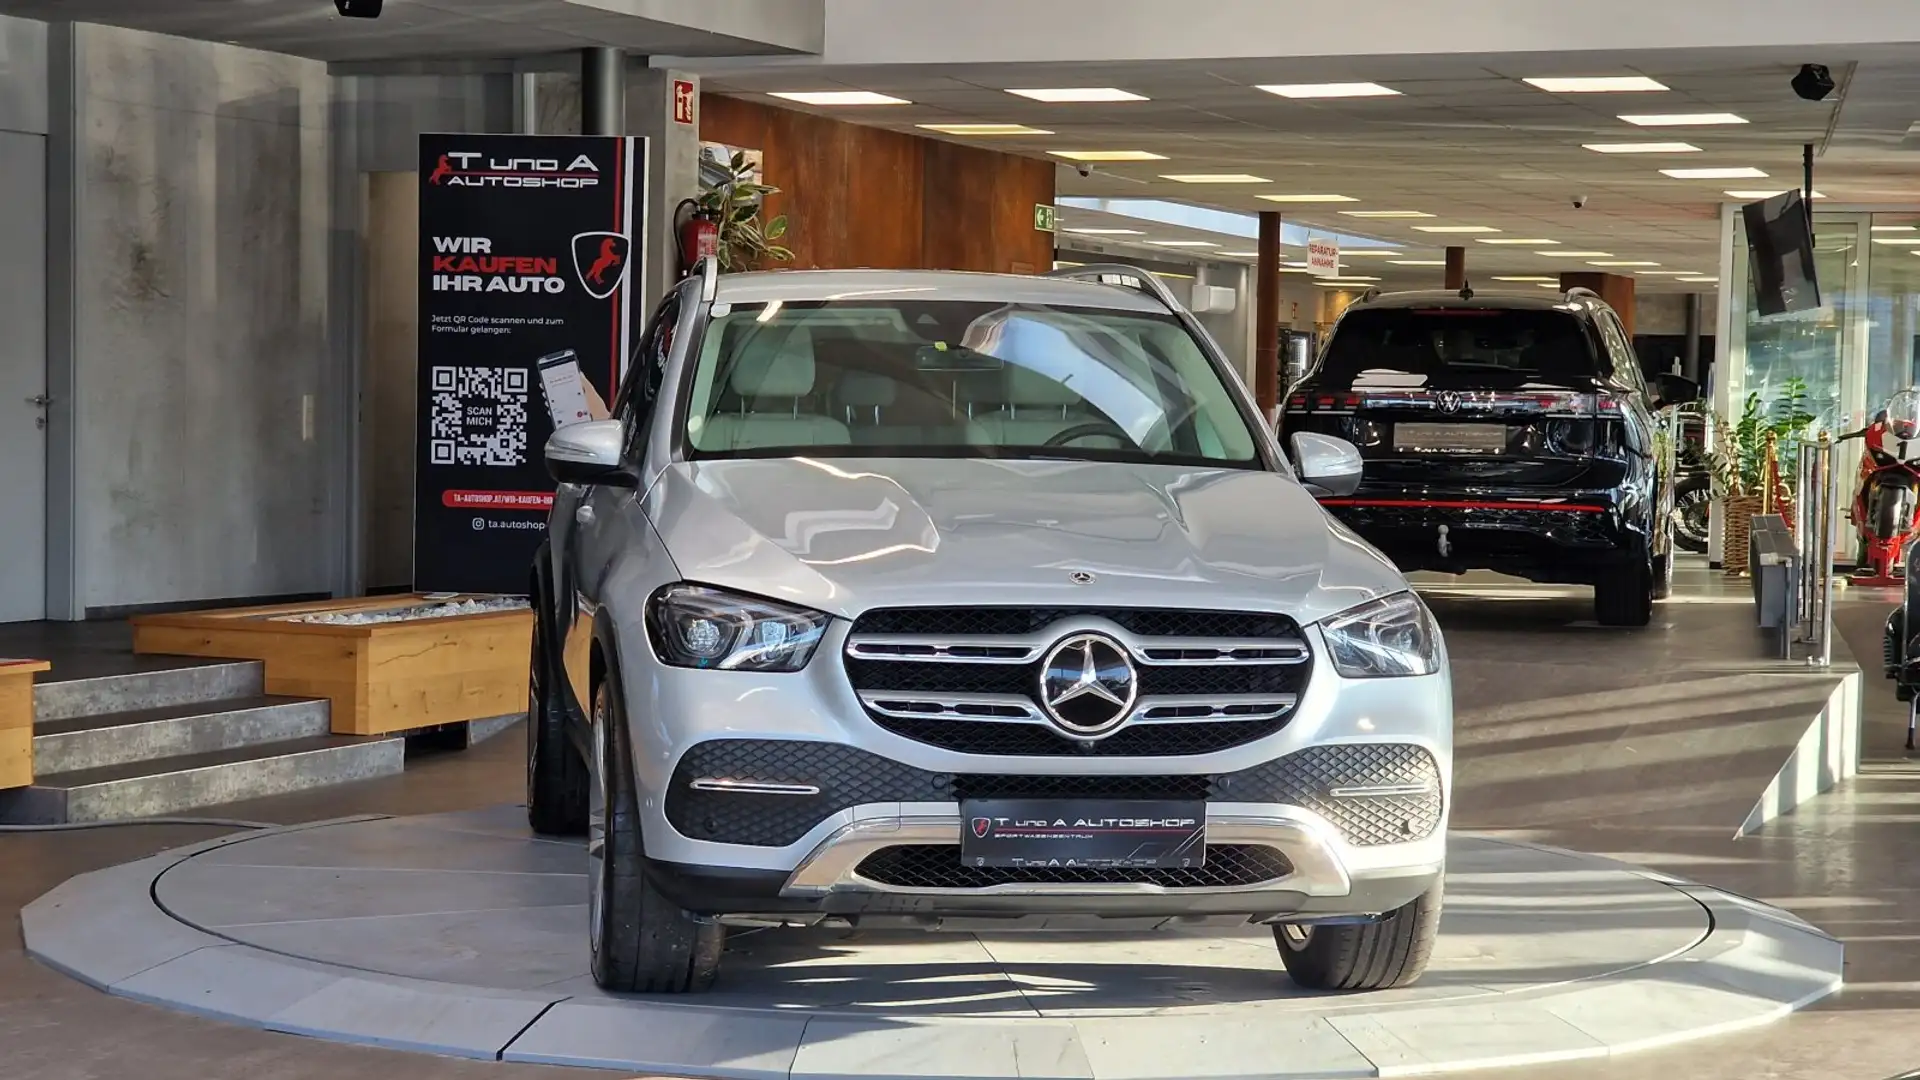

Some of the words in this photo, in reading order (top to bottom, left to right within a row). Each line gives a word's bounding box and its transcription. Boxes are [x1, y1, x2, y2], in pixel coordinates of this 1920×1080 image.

[448, 152, 482, 169] T
[565, 154, 599, 171] A
[448, 176, 599, 188] AUTOSHOP
[433, 237, 492, 254] WIR
[433, 256, 557, 274] KAUFEN
[433, 275, 483, 292] IHR
[486, 276, 565, 294] AUTO
[432, 314, 451, 323] Jetzt
[453, 315, 466, 324] QR
[468, 315, 489, 324] Code
[432, 325, 469, 333] Formular
[470, 326, 512, 335] gelangen:
[466, 406, 492, 416] SCAN
[466, 416, 492, 426] MICH
[488, 520, 546, 531] ta.autoshop
[994, 818, 1010, 826] T
[1052, 818, 1067, 827] A
[1073, 818, 1195, 827] AUTOSHOP
